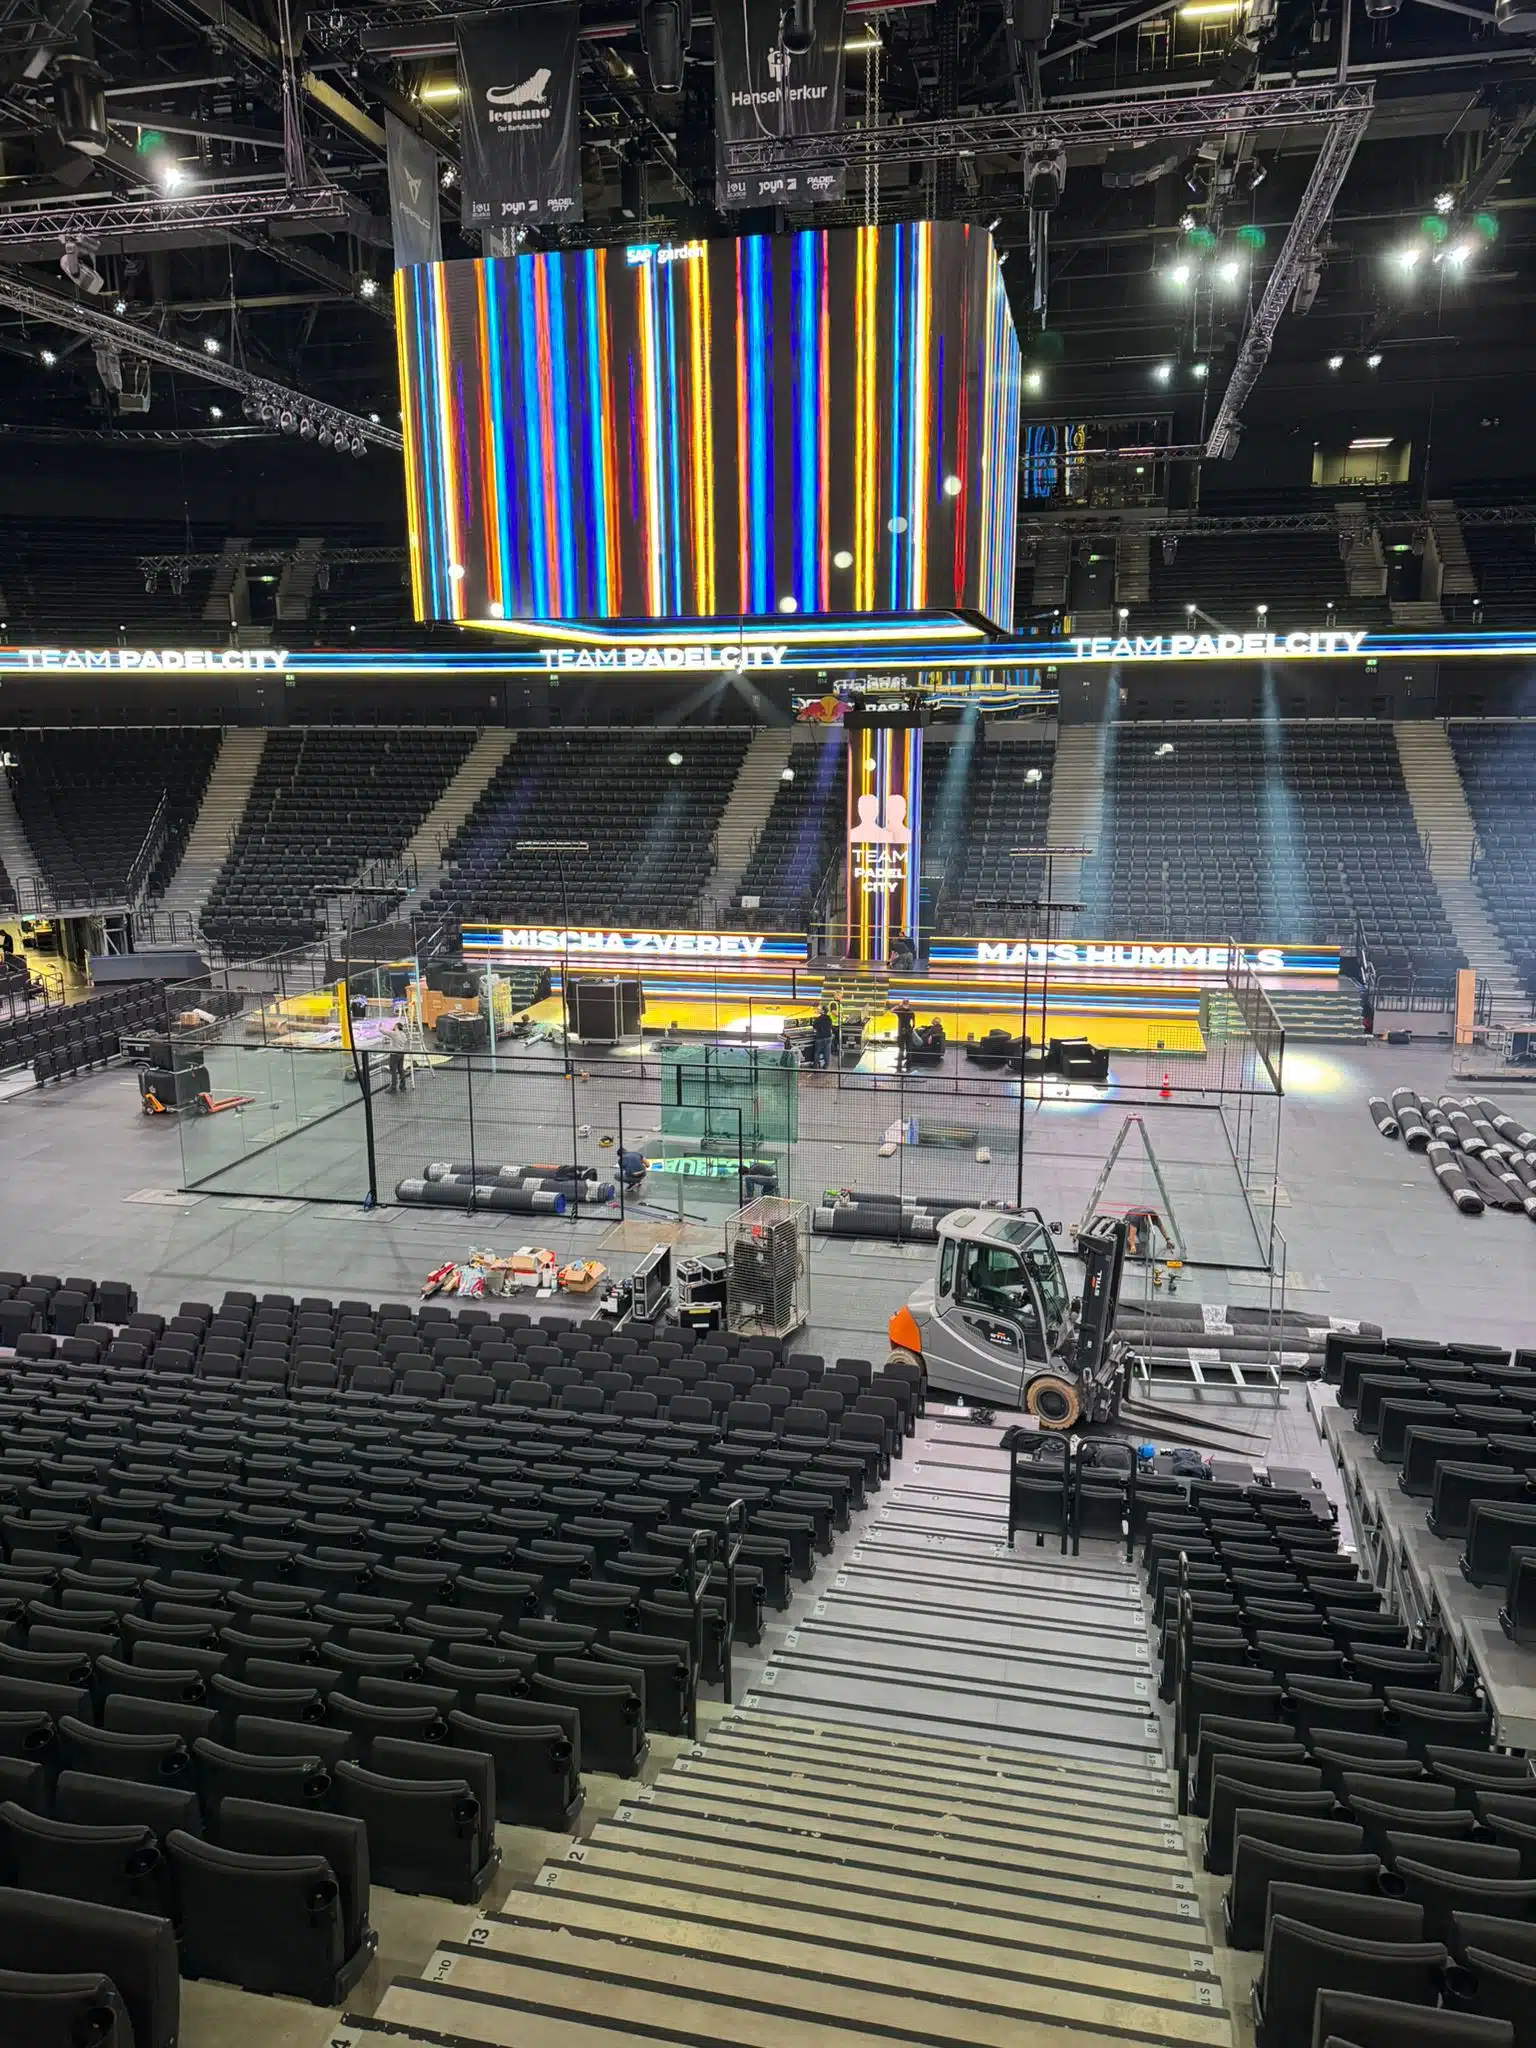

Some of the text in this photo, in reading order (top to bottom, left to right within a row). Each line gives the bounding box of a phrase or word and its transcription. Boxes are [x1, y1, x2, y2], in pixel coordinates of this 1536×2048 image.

[489, 108, 550, 124] leguano
[758, 179, 783, 195] joyn
[807, 175, 836, 184] PADEL
[811, 182, 830, 190] CITY
[501, 201, 525, 216] joyn
[547, 198, 575, 206] PADEL
[626, 245, 704, 264] SAP garden
[1070, 631, 1368, 658] TEAM PADELCITY
[19, 649, 289, 669] TEAM PADELCITY
[539, 646, 788, 668] TEAM PADELCITY
[852, 849, 908, 863] TEAM
[854, 867, 906, 879] PADEL
[863, 882, 898, 893] CITY
[501, 928, 765, 957] MISCHA ZVEREV
[978, 942, 1285, 971] MATS HUMMELS
[1094, 1269, 1103, 1296] STILL
[990, 1332, 1012, 1342] STILL
[468, 1928, 490, 1946] 13
[433, 1959, 452, 1981] 1-10
